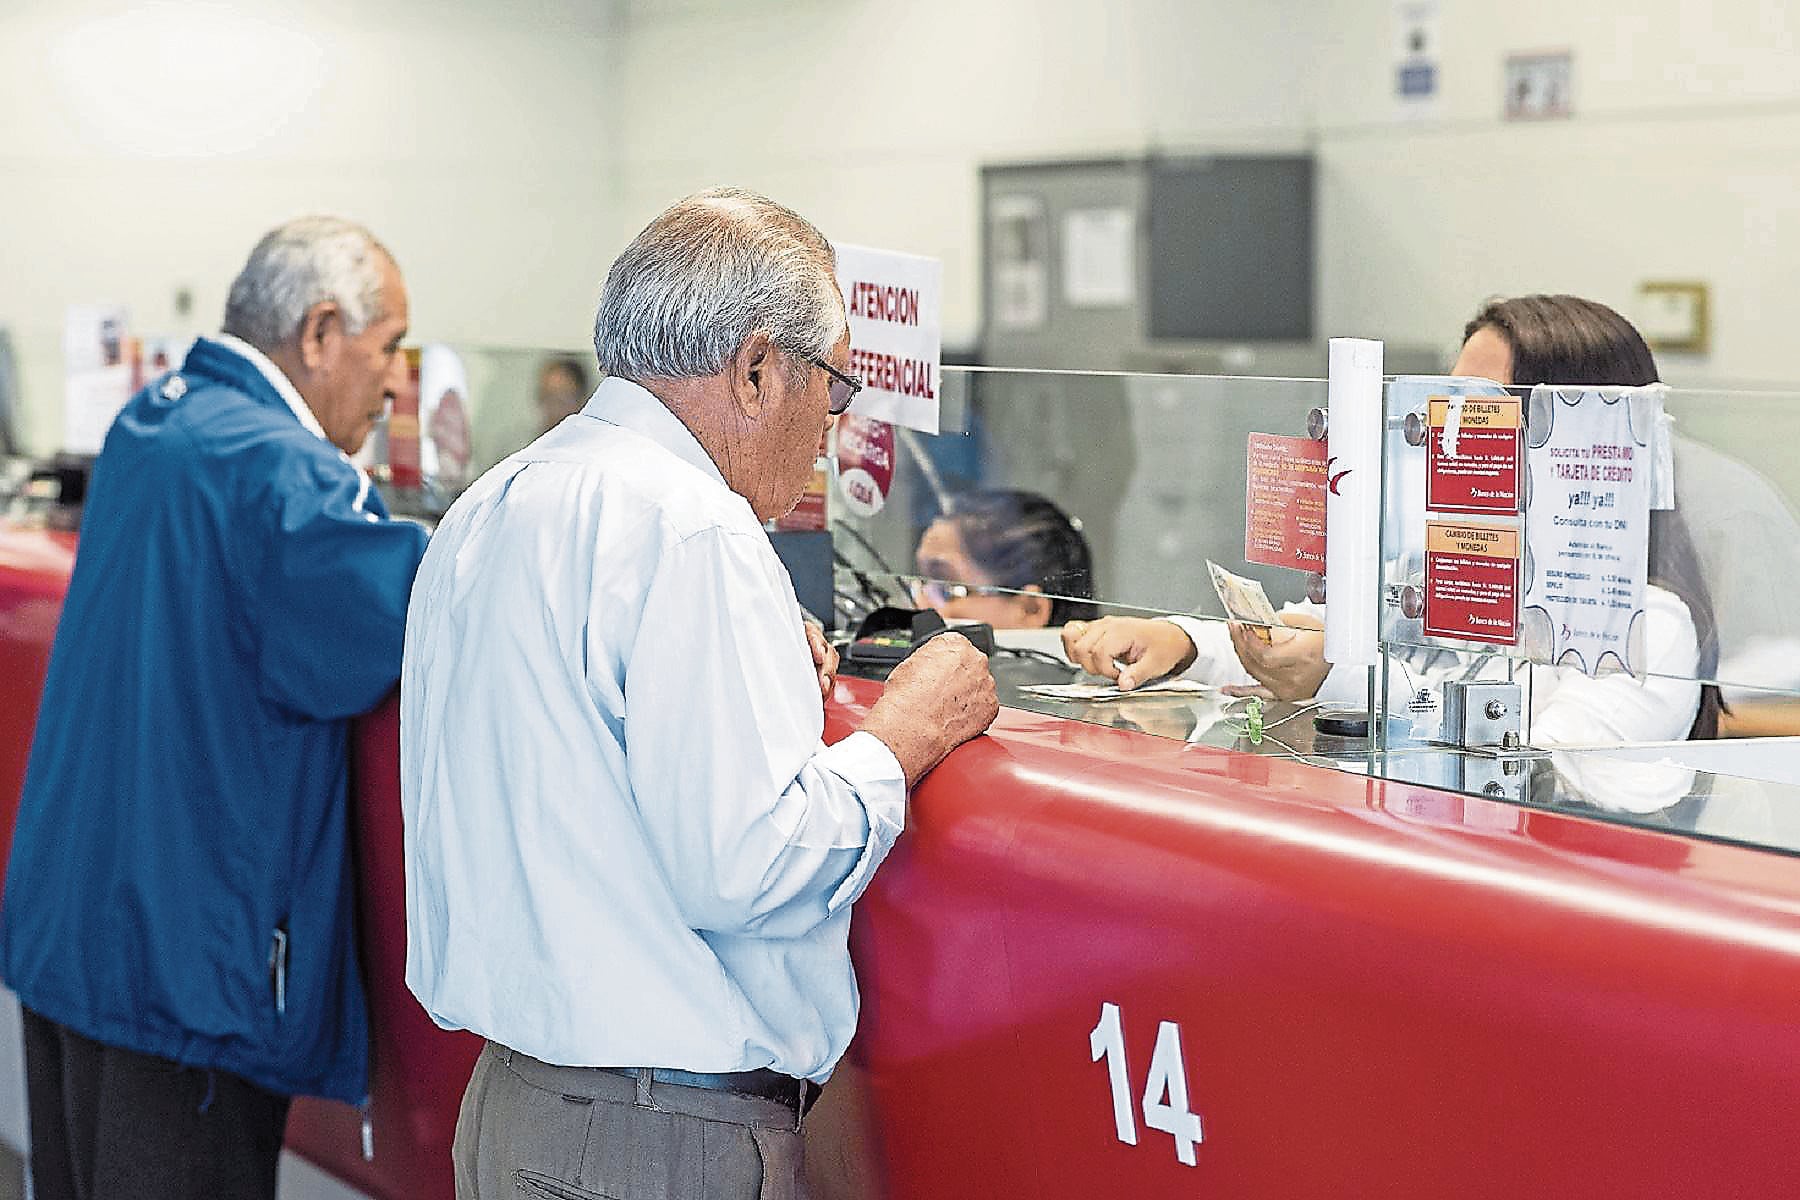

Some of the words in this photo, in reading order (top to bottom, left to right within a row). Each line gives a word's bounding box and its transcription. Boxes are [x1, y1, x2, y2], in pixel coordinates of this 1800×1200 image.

[850, 281, 919, 327] ATENCION
[1477, 404, 1500, 413] BILLETES
[1463, 415, 1489, 425] MONEDAS
[1592, 444, 1633, 460] PRESTAMO
[1556, 464, 1588, 481] TARJETA
[1591, 465, 1600, 481] DE
[1603, 466, 1633, 482] CREDITO
[1568, 491, 1590, 509] ya!!!
[1592, 492, 1614, 510] ya!!!
[1553, 515, 1587, 527] Consulta
[1446, 529, 1467, 539] CAMBIO
[1475, 531, 1499, 542] BILLETES
[1461, 543, 1488, 553] MONEDAS
[1090, 1001, 1203, 1168] 14
